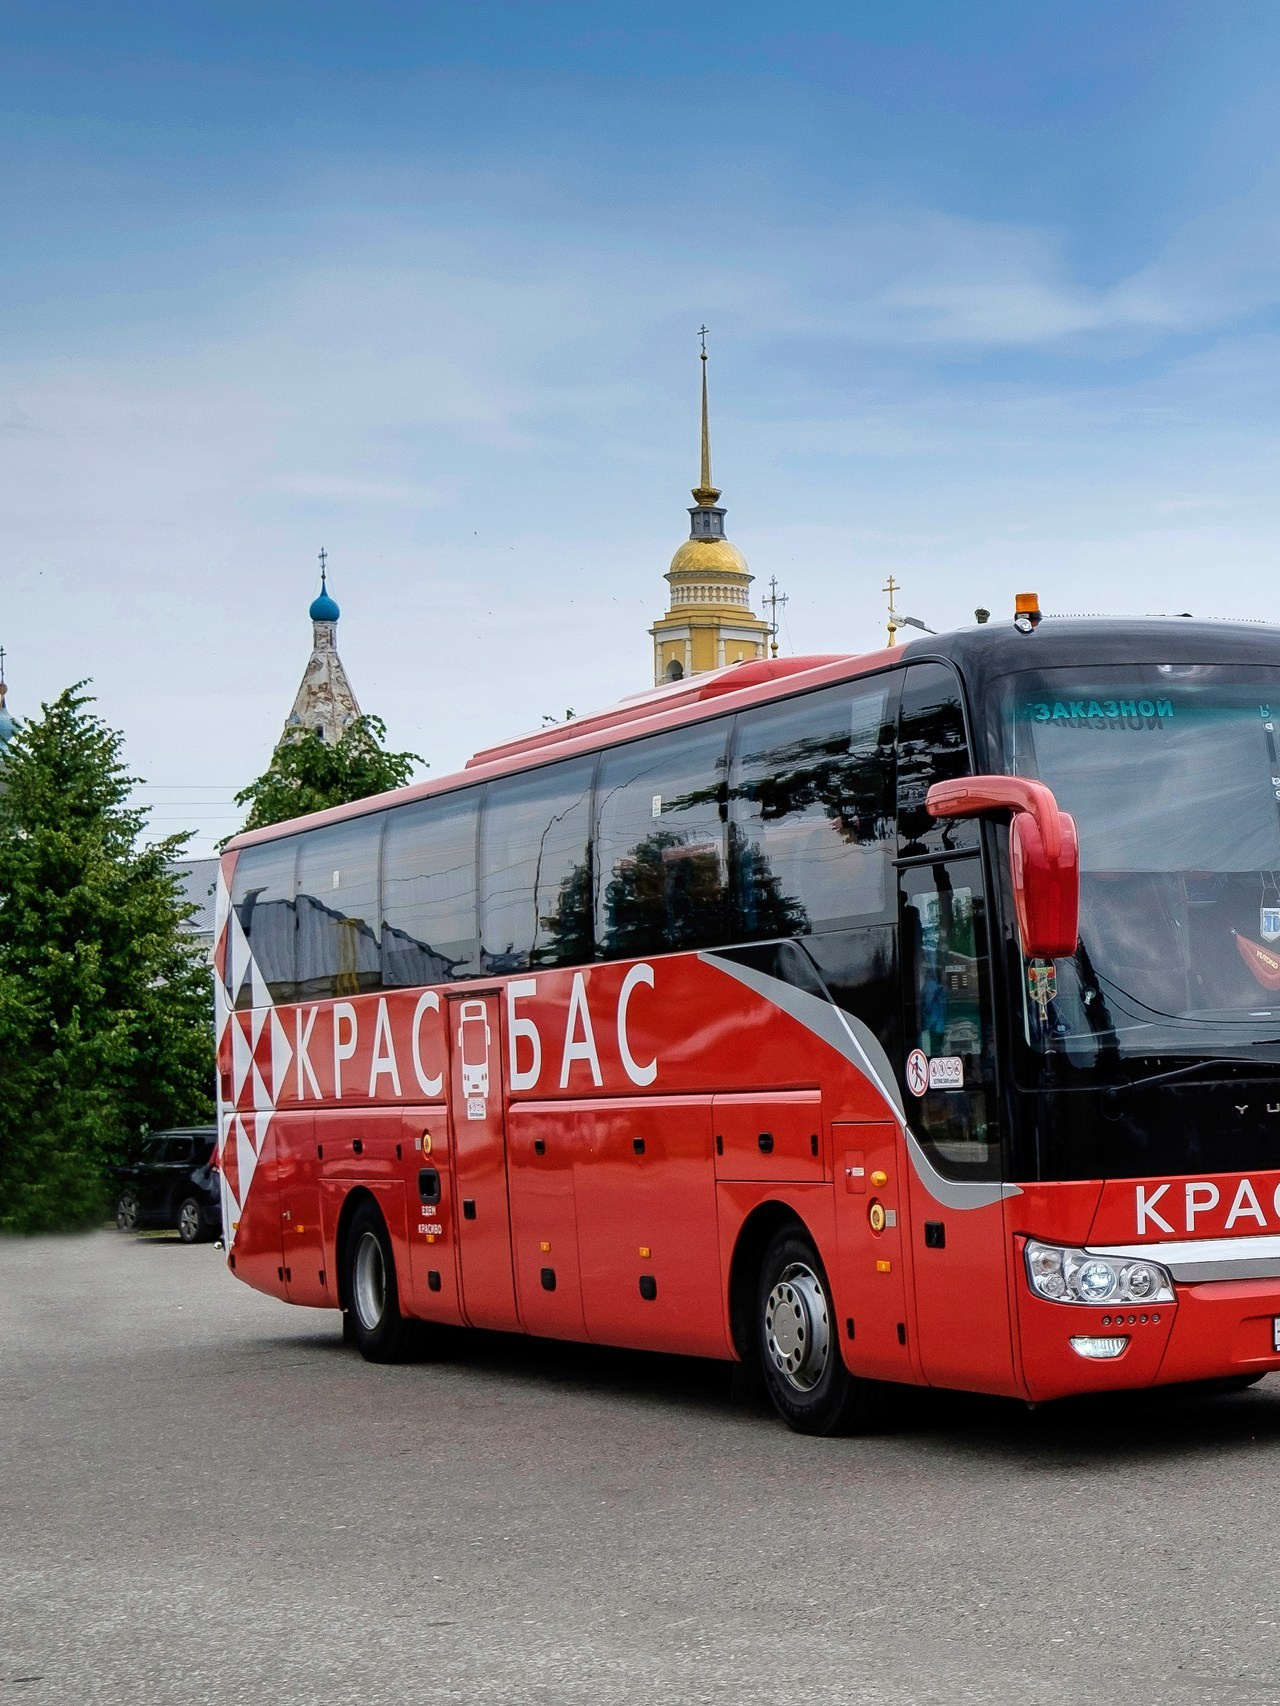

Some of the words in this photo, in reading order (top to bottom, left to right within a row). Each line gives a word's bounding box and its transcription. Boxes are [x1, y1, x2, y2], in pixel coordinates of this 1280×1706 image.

[1033, 697, 1174, 720] ЗАКАЗНОЙ
[296, 990, 443, 1101] КРАС
[507, 963, 658, 1091] БАС
